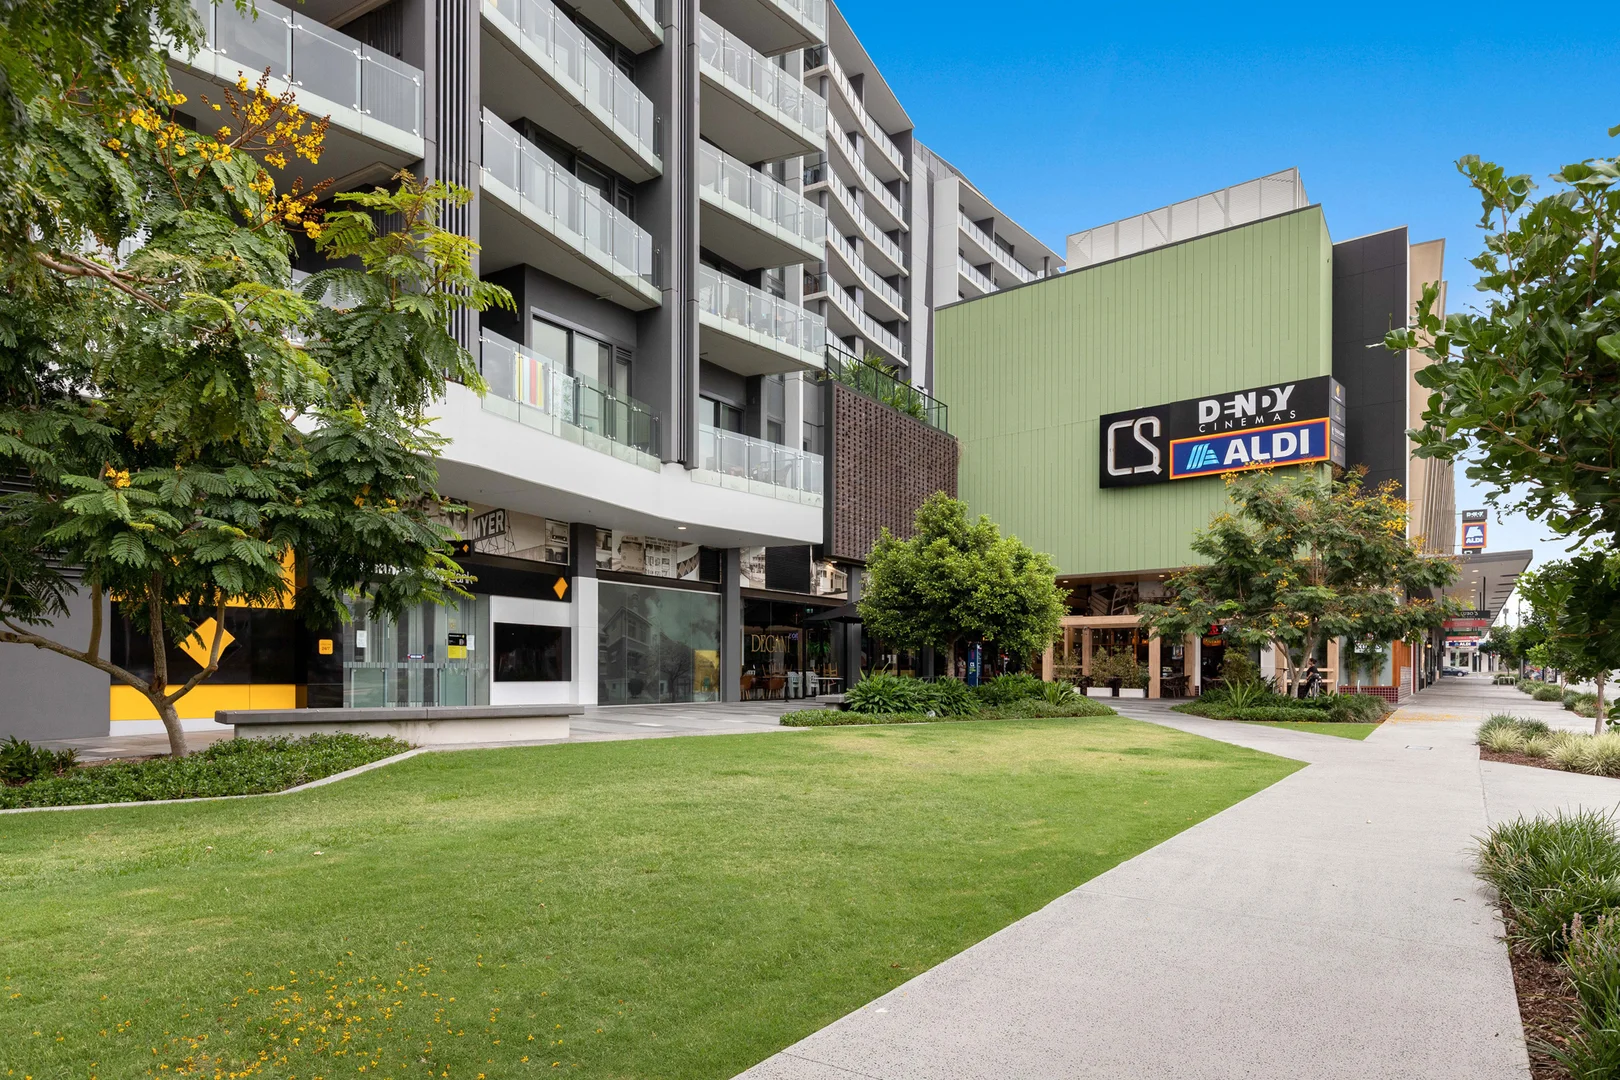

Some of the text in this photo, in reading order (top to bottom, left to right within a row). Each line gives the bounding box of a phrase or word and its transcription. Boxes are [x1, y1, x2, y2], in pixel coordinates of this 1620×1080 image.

[1198, 384, 1296, 425] DENDY
[1198, 410, 1297, 433] CINEMAS
[1223, 428, 1309, 465] ALDI
[472, 509, 505, 540] MYER
